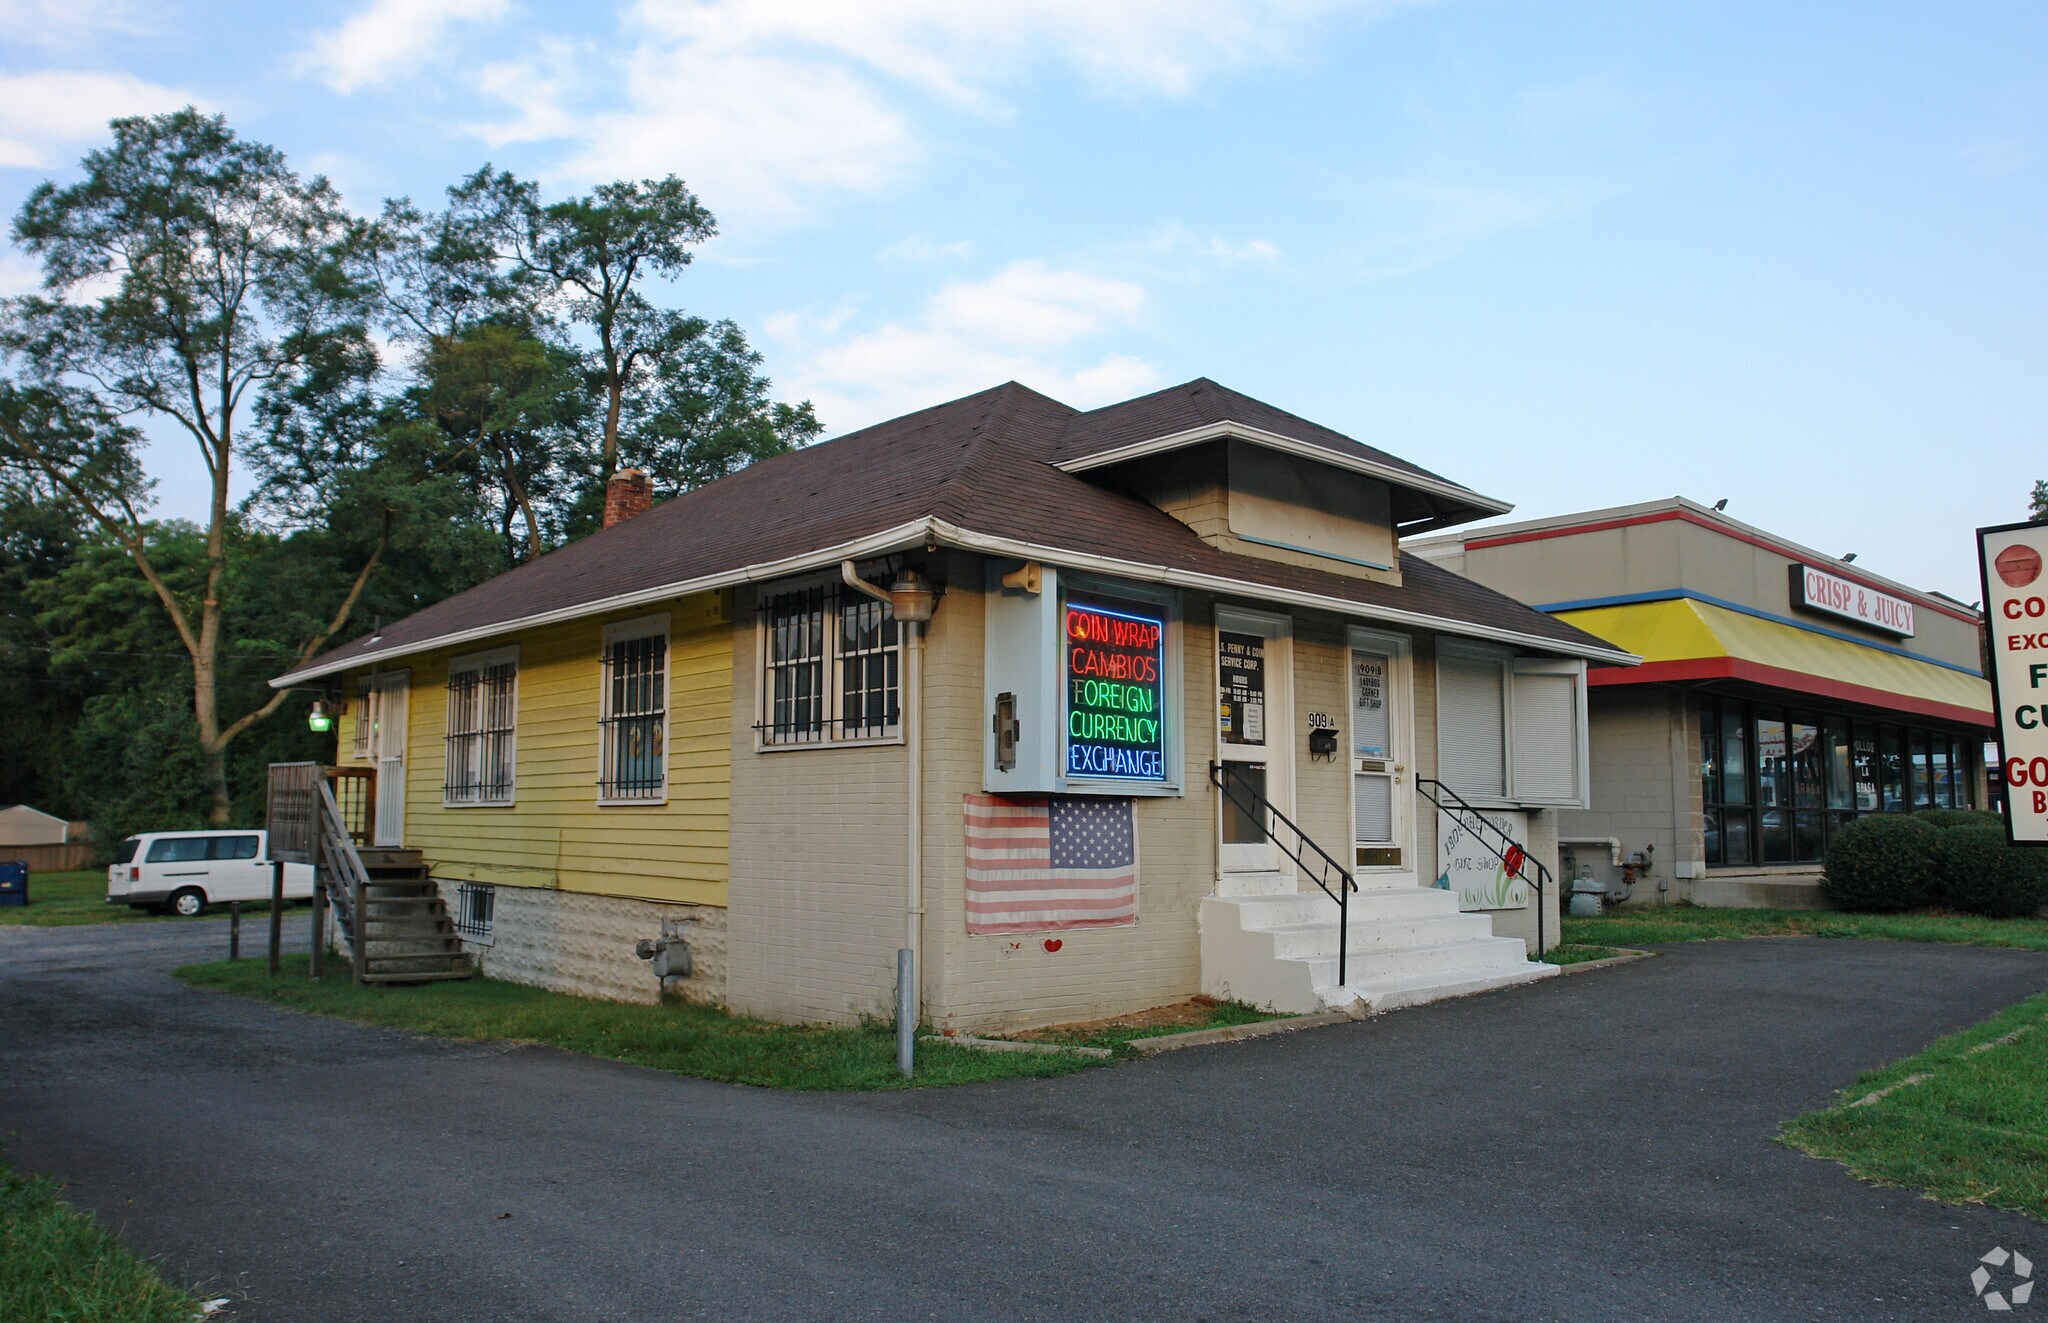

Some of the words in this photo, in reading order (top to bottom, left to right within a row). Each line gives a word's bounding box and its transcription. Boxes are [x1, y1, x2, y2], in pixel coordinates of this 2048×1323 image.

[1806, 571, 1851, 611] CRISP
[1857, 589, 1868, 617] &
[1875, 596, 1911, 630] JUICY
[2003, 597, 2048, 619] CO
[1066, 611, 1109, 642] COIN
[1113, 619, 1159, 649] WRAP
[1227, 643, 1244, 655] PENNY
[1246, 646, 1251, 656] &
[1072, 648, 1156, 682] CAMBIOS
[1221, 656, 1242, 669] SERVICE
[1244, 659, 1259, 671] CORP.
[1233, 675, 1248, 685] HOURS
[1072, 679, 1152, 713] FOREIGN
[1070, 710, 1157, 743] CURRENCY
[1309, 712, 1327, 728] 909
[1330, 717, 1335, 727] A
[1071, 744, 1160, 775] EXCHANGE
[1856, 782, 1876, 793] BRASA
[1476, 856, 1499, 871] SHOP
